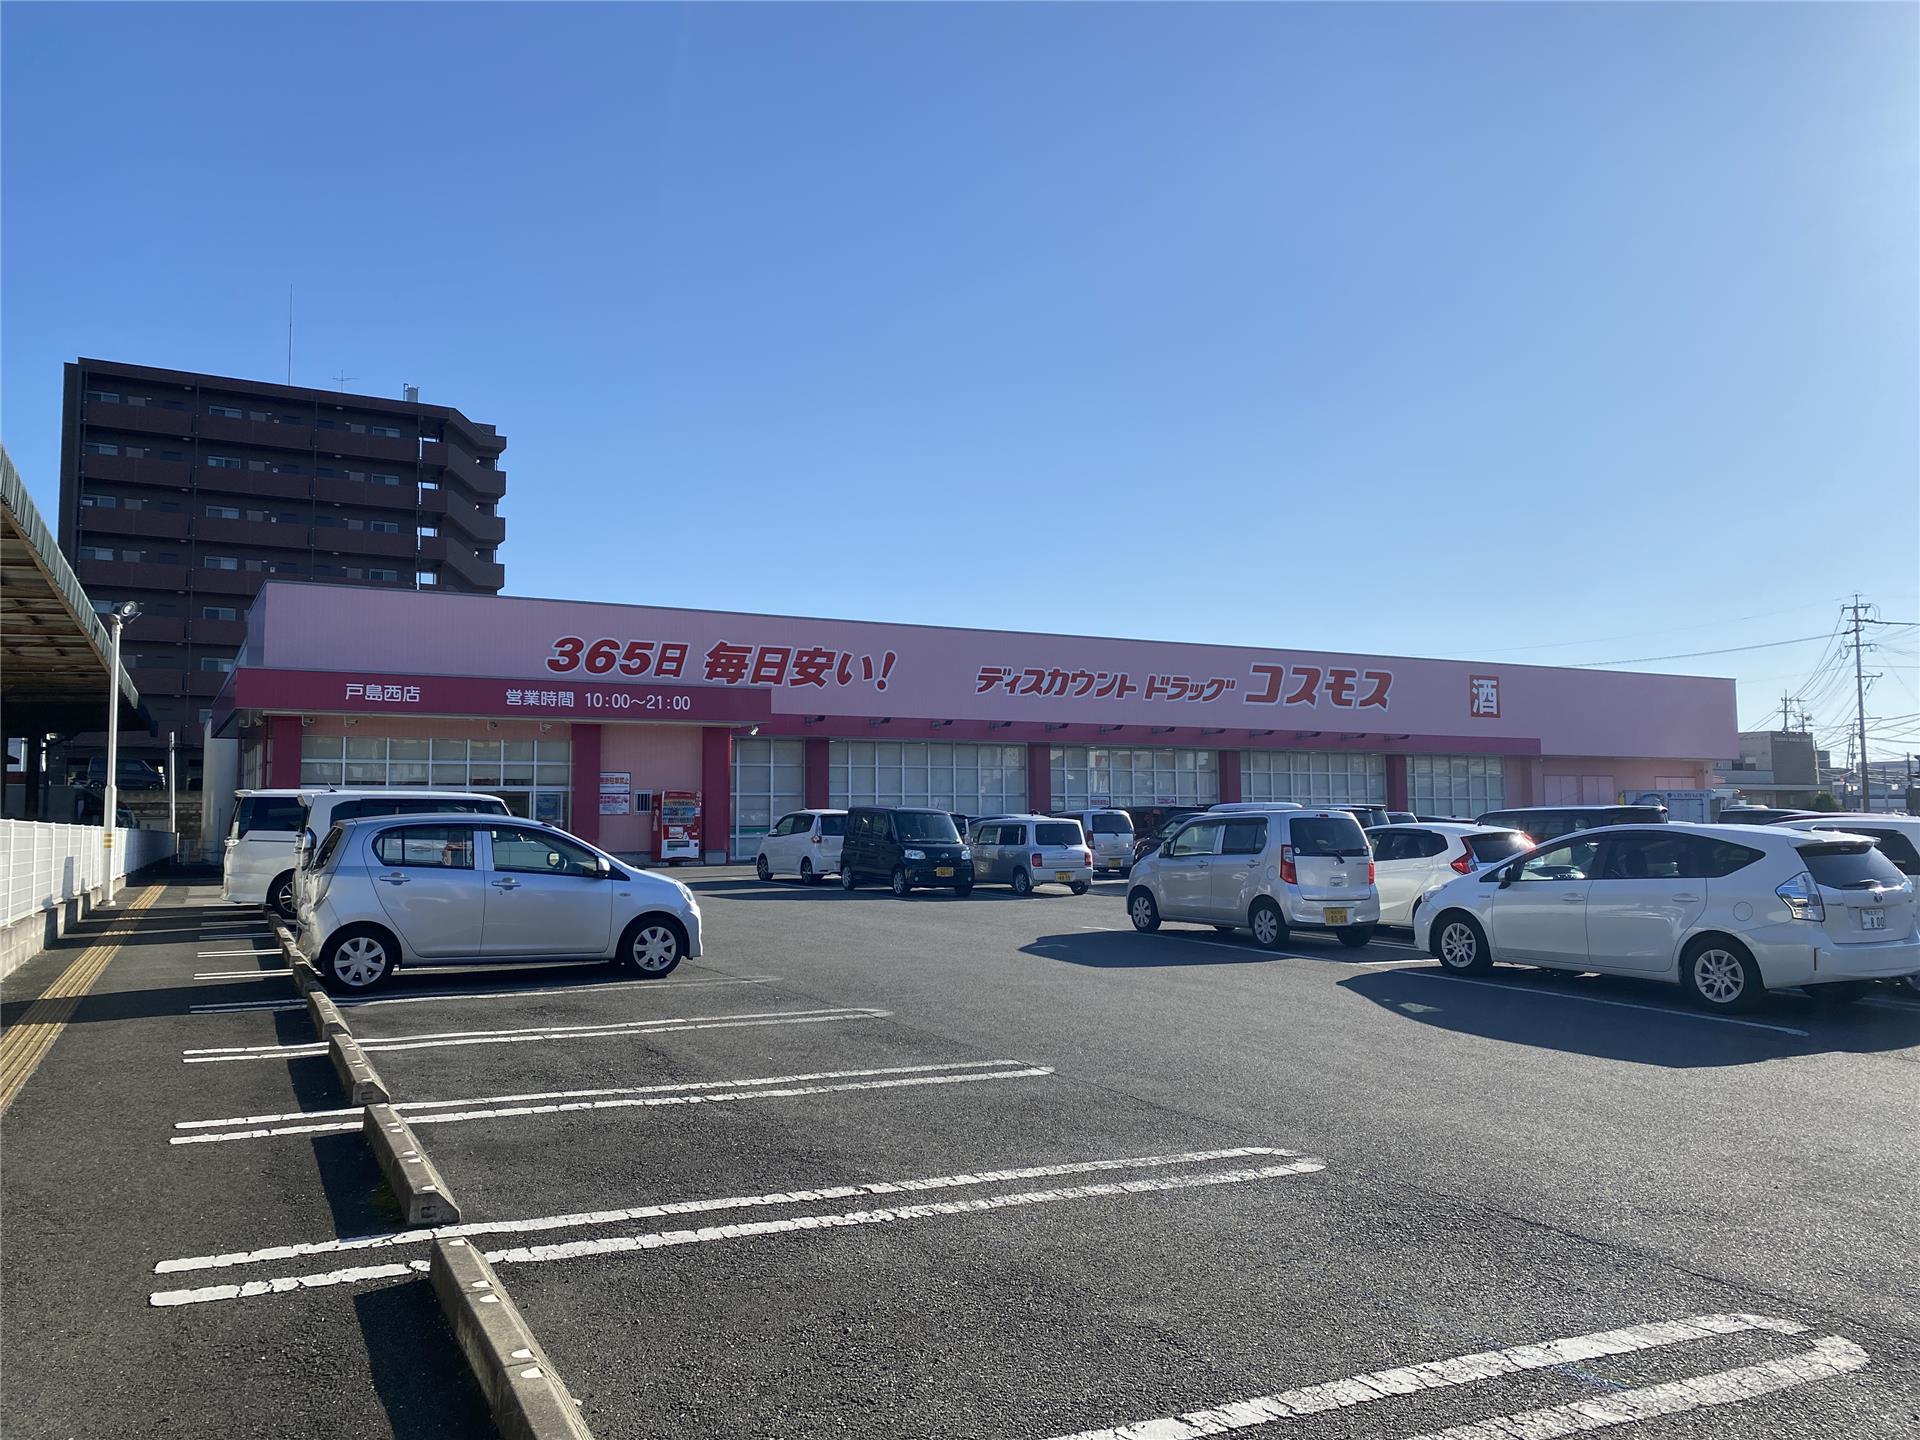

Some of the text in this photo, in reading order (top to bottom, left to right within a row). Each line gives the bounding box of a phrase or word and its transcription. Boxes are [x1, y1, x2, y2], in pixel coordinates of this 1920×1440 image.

[546, 636, 897, 692] 365日 毎日安い!
[345, 683, 421, 702] 戸島西店
[505, 689, 575, 708] 営業時間
[975, 663, 1393, 711] ディスカウント ドラッグ コスモス
[1472, 679, 1498, 714] 酒
